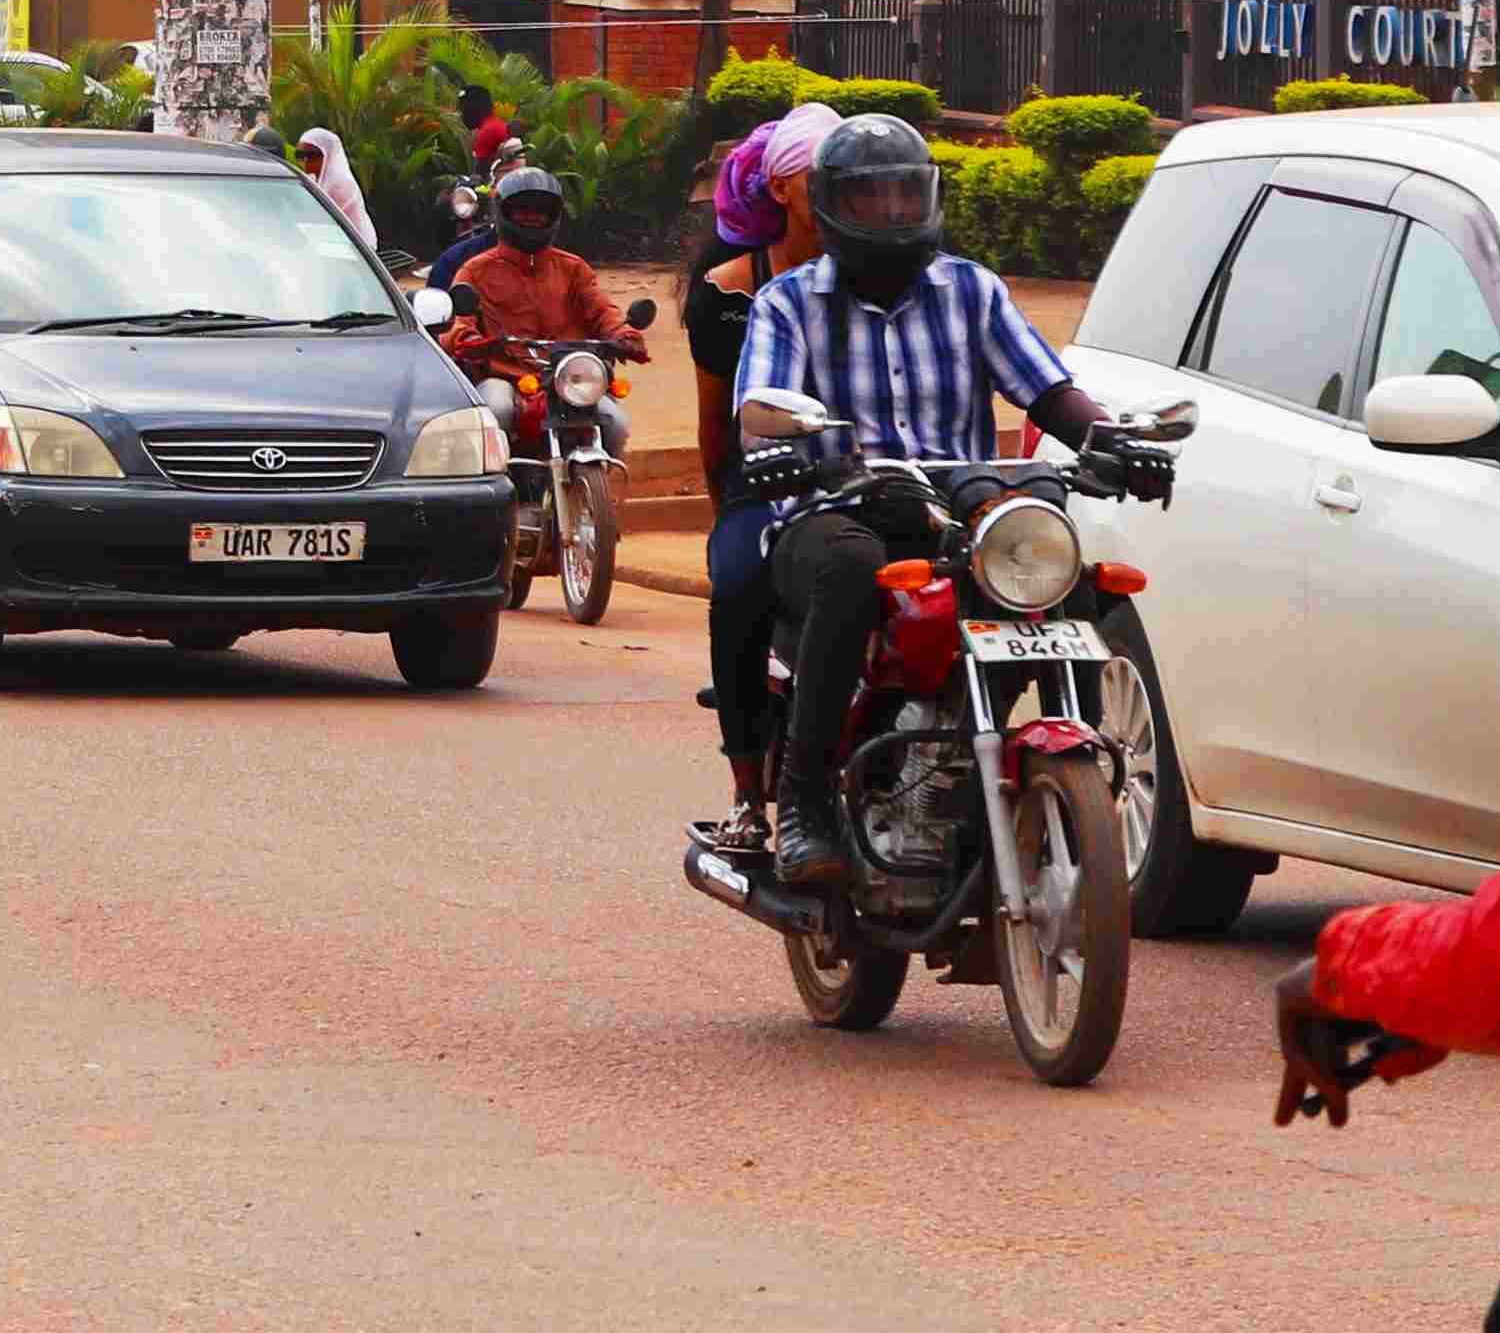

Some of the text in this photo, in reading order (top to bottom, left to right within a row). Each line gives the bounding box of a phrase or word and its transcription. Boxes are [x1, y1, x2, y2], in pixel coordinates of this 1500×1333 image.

[1347, 5, 1464, 69] COURT
[223, 525, 352, 559] UAR 781S
